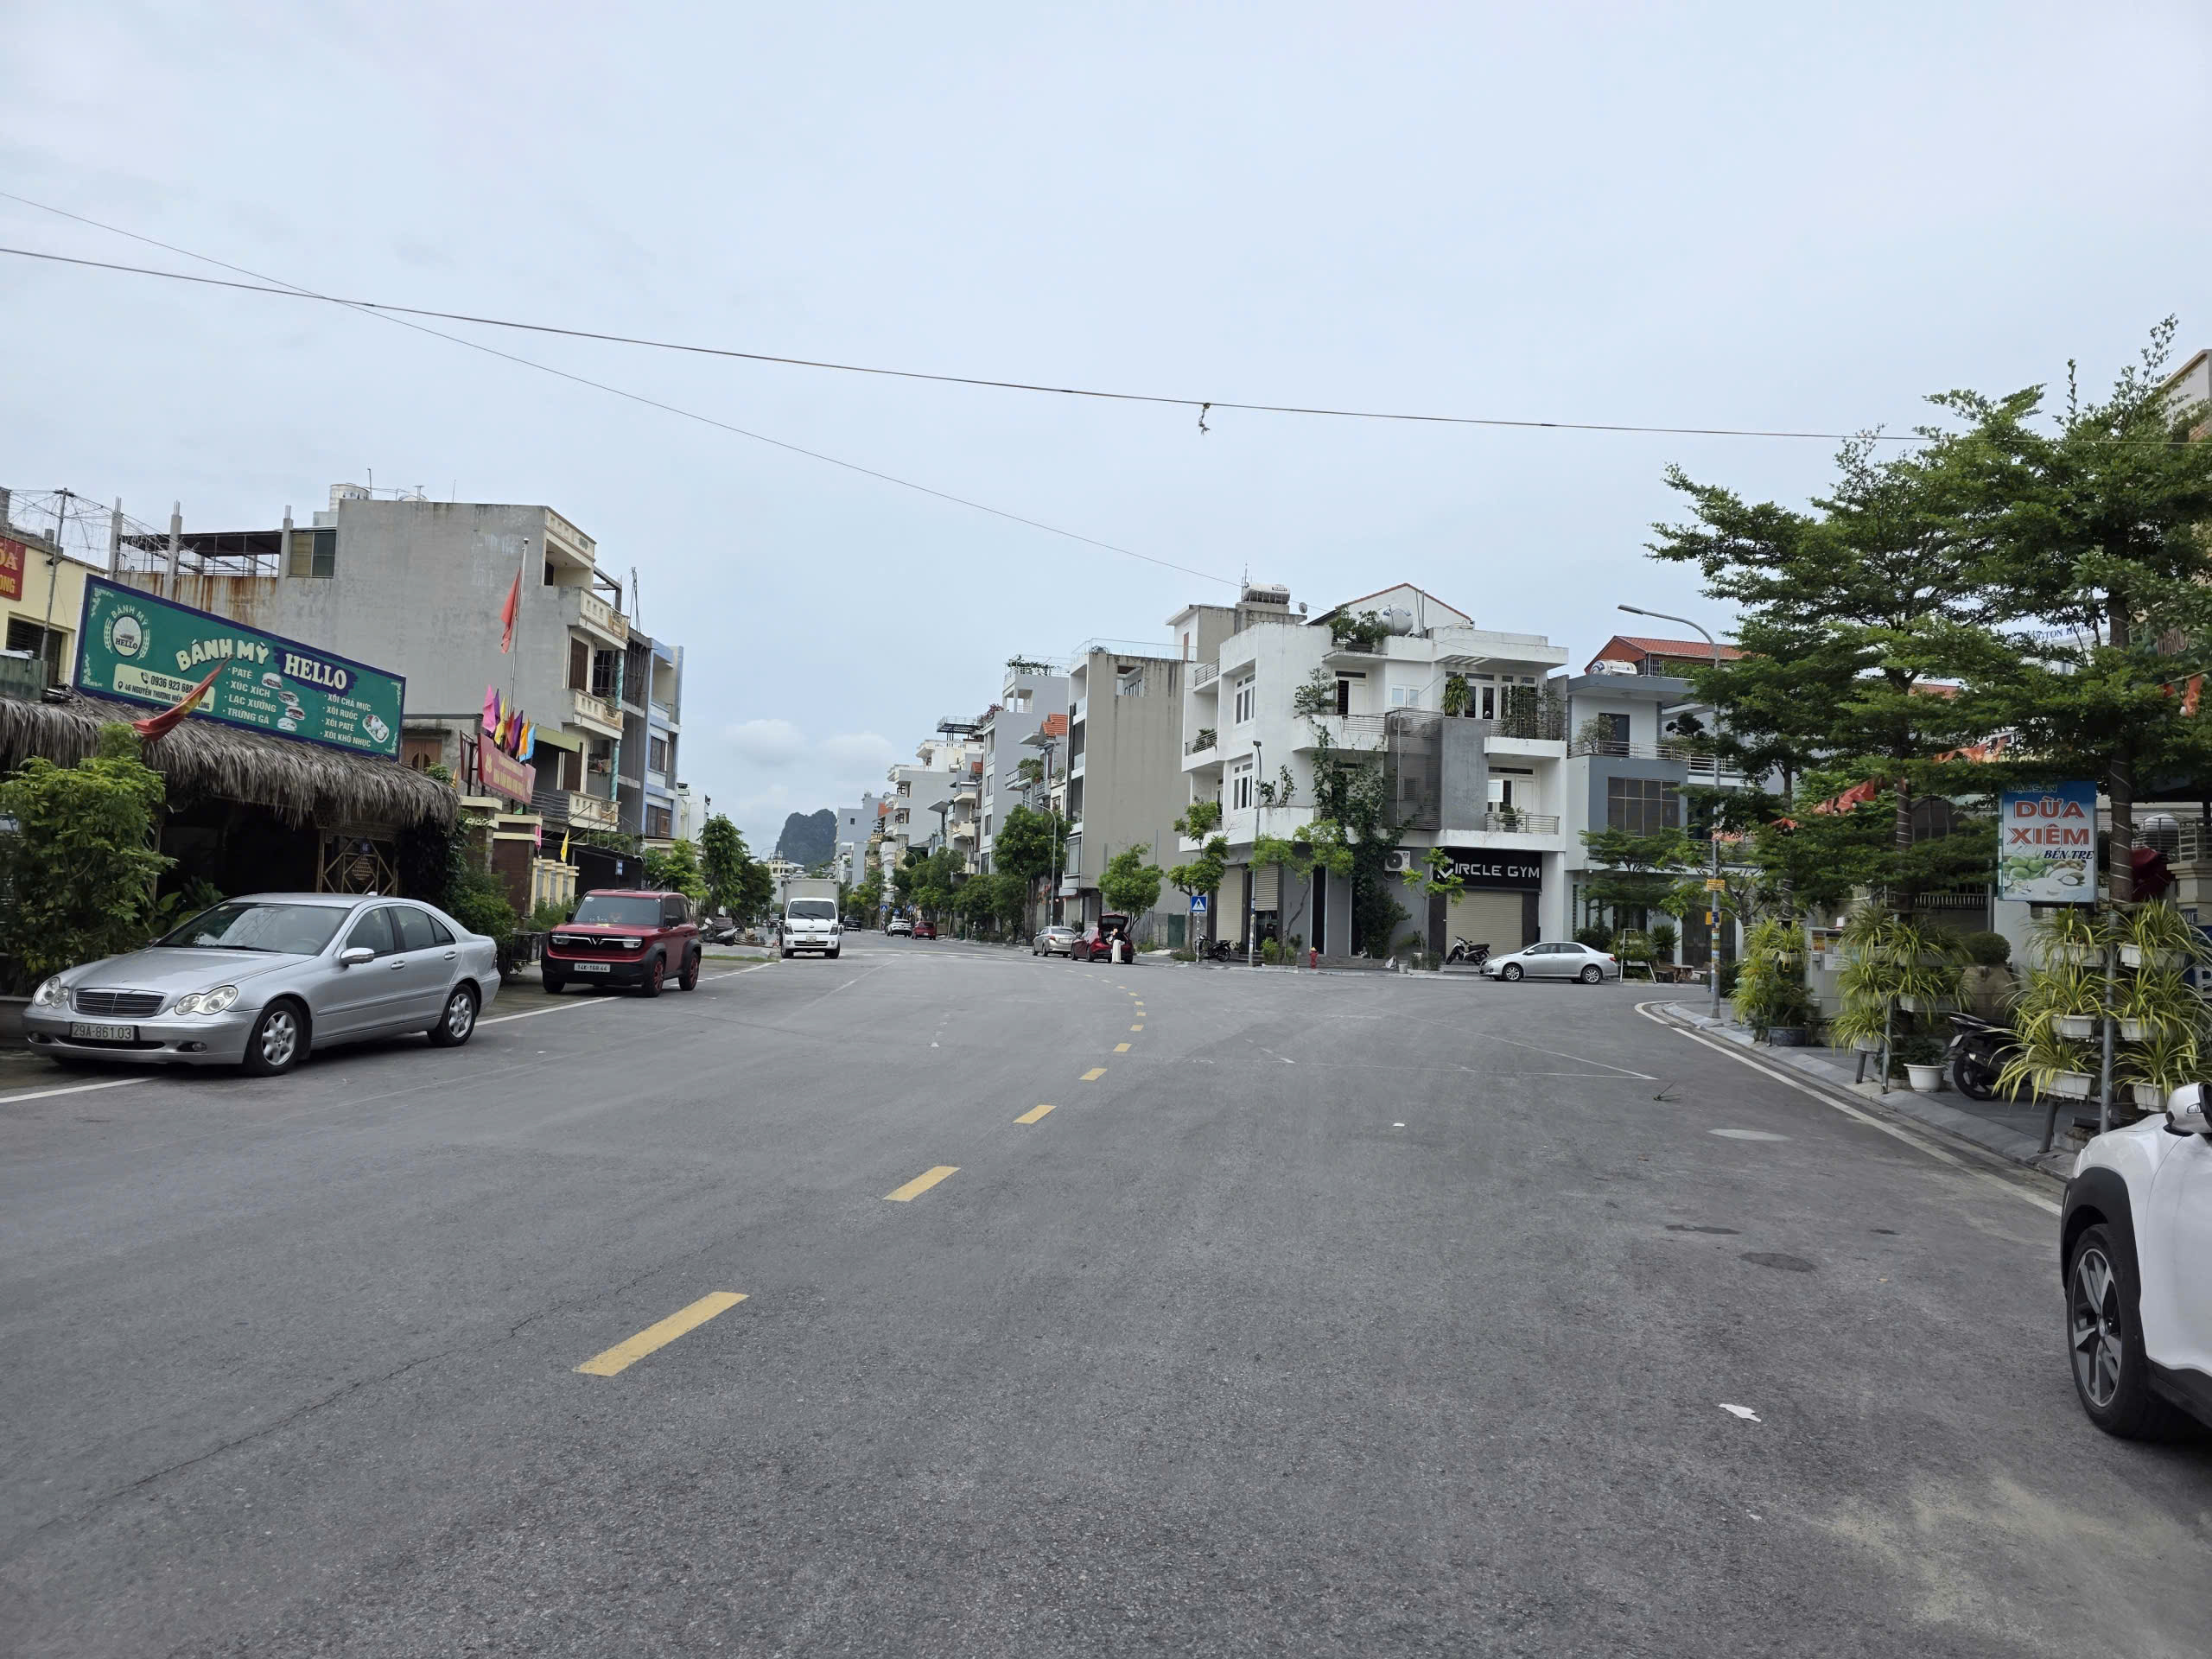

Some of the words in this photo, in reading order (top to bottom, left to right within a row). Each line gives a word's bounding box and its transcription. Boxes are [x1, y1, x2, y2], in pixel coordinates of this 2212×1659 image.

[111, 604, 136, 619] BÁNH
[115, 638, 138, 650] HELLO
[175, 639, 233, 671] BÁNH
[237, 639, 270, 664] MỲ
[283, 653, 347, 690] HELLO
[150, 675, 168, 688] 0936
[168, 679, 181, 691] 923
[230, 680, 248, 692] XÚC
[251, 685, 270, 697] XÍCH
[228, 694, 245, 706] LẠC
[227, 707, 257, 721] TRỨNG
[2014, 796, 2086, 819] DỪA
[2007, 823, 2090, 846] XIÊM
[1507, 866, 1540, 878] GYM
[73, 1024, 132, 1039] 29A-861.03
